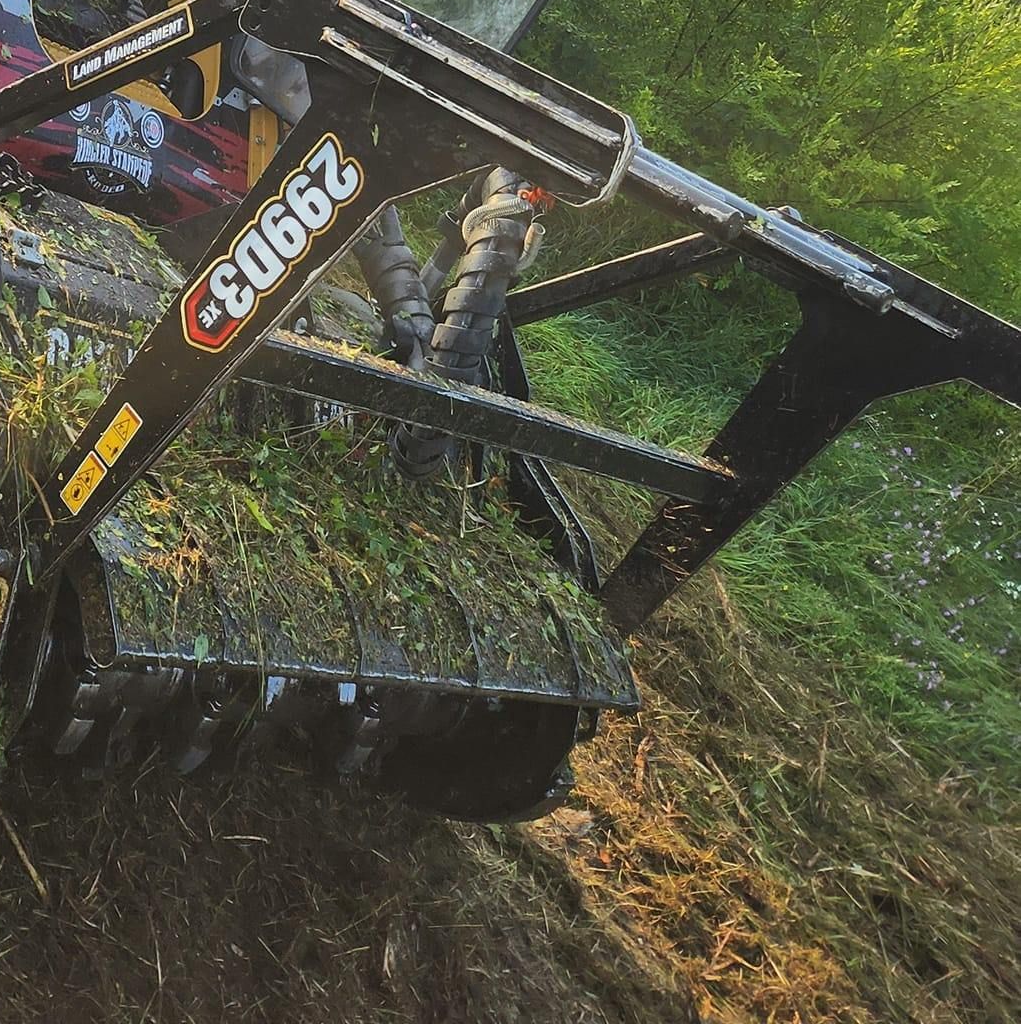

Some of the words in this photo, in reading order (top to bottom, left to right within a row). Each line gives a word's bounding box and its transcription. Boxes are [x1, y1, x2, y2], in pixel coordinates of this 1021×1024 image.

[73, 56, 102, 80] LAND
[104, 17, 184, 65] MANAGEMENT
[87, 175, 126, 193] RODEO
[112, 149, 153, 187] STAMPEDE
[209, 141, 360, 319] 299D3
[198, 302, 223, 328] XE
